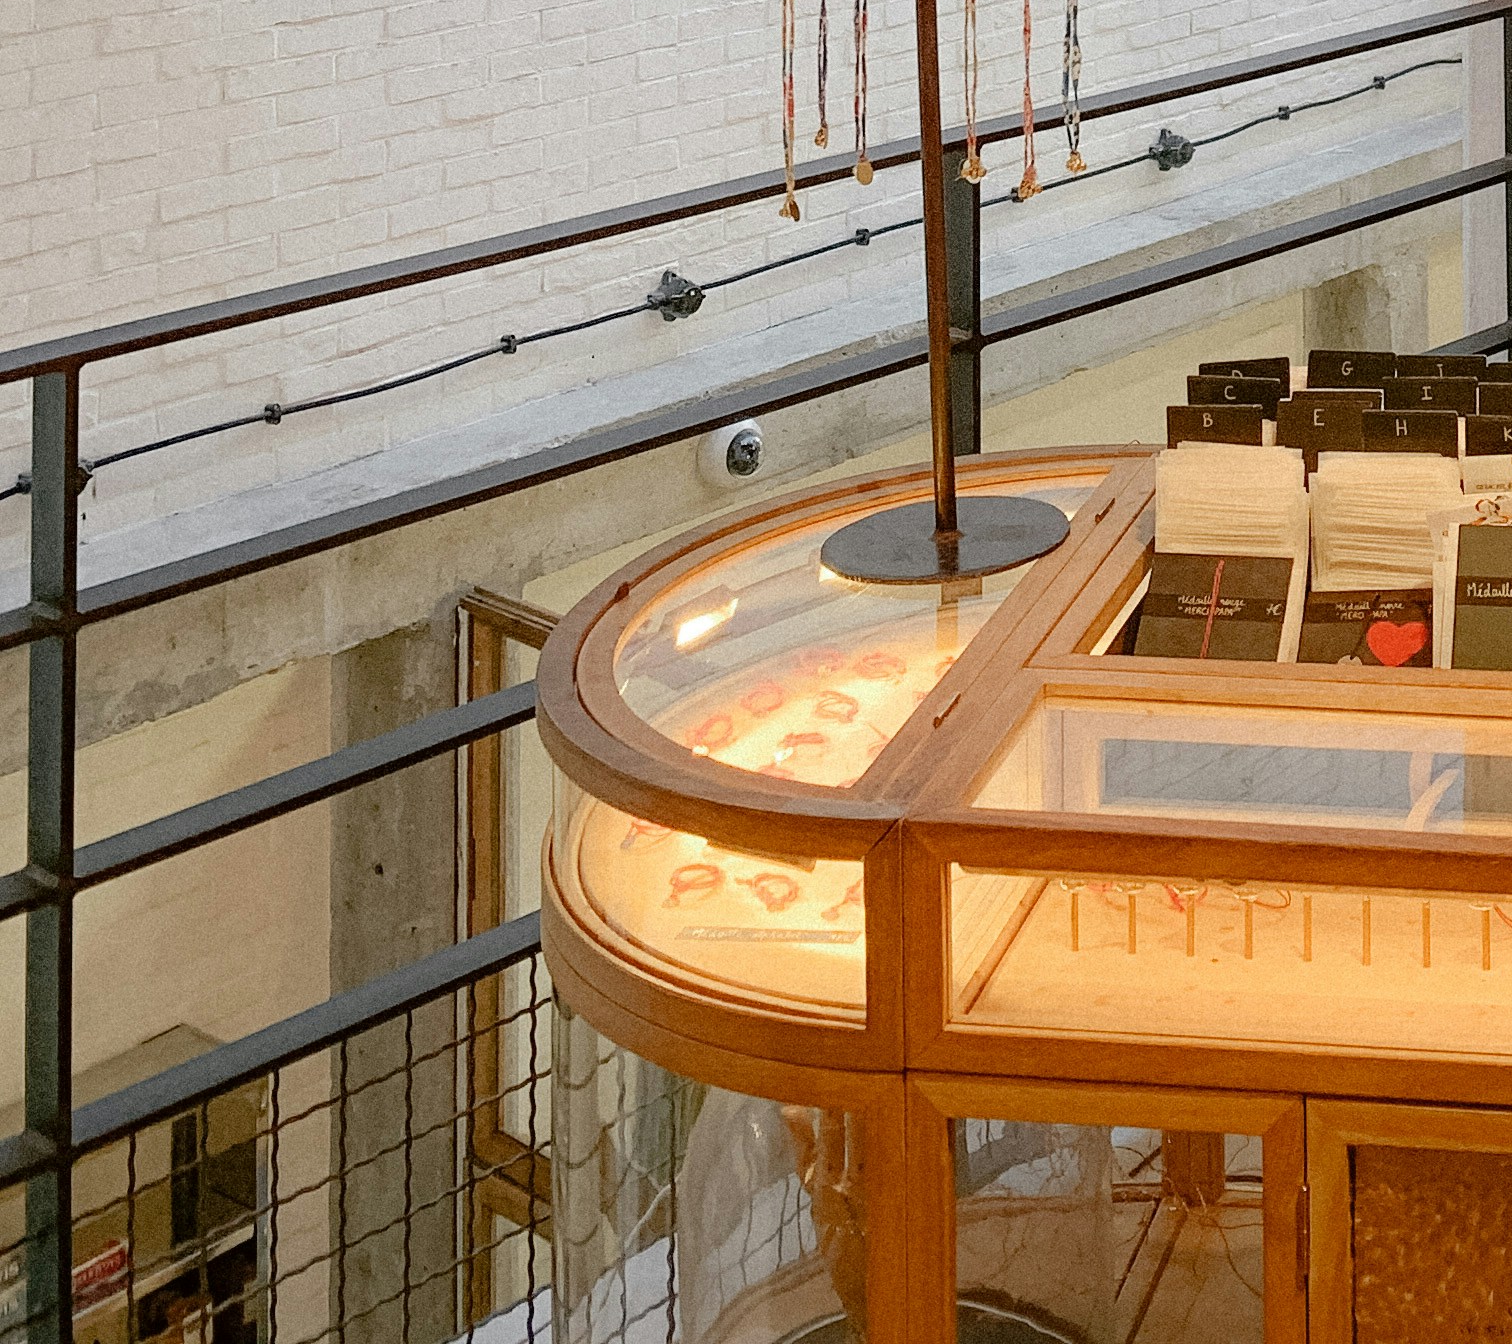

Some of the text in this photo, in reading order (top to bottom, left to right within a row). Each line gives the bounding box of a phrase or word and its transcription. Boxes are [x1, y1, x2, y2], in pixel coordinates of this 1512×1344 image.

[1341, 360, 1354, 376] G
[1224, 385, 1237, 400] C
[1421, 385, 1433, 401] I
[1202, 412, 1214, 428] B
[1313, 408, 1325, 427] E
[1395, 418, 1408, 437] H
